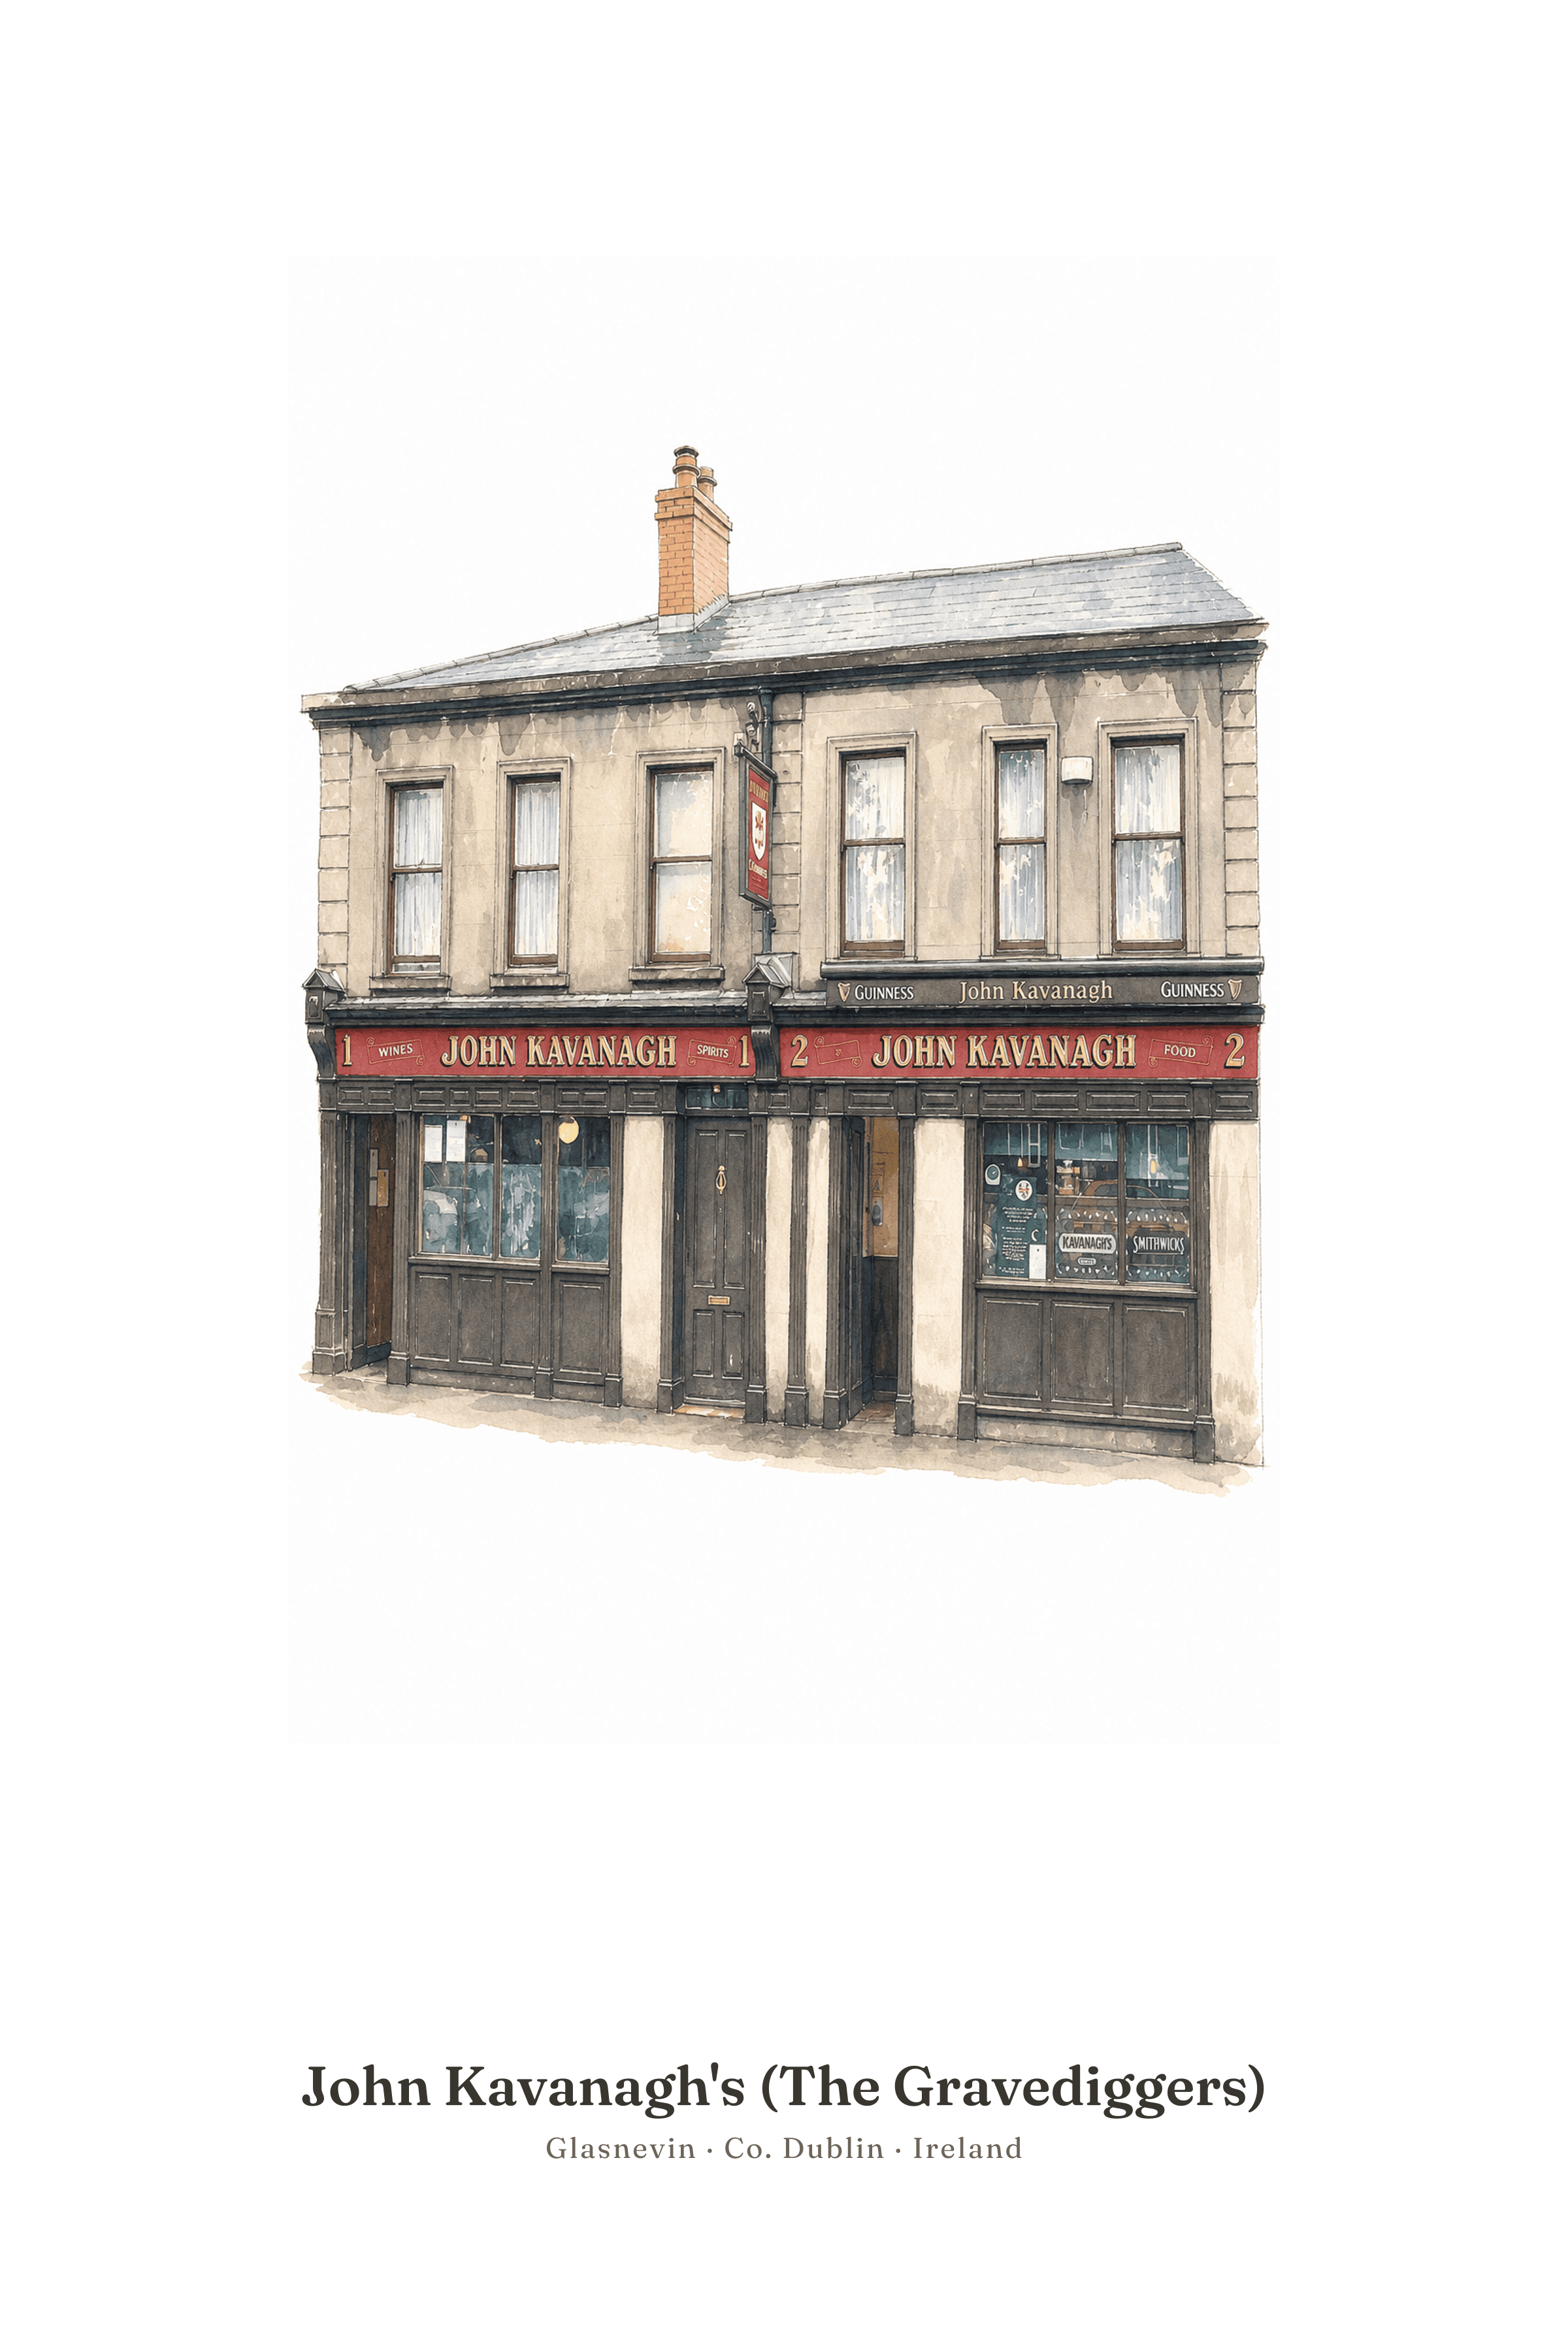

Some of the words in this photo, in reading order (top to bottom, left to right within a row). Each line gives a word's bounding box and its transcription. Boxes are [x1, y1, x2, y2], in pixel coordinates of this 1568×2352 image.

[855, 985, 914, 1000] GUINNESS
[958, 981, 1004, 1004] John
[1012, 980, 1113, 1004] Kavanagh
[1161, 981, 1224, 998] GUINNESS
[342, 1034, 352, 1066] 1
[378, 1043, 413, 1057] WINES
[440, 1035, 517, 1068] JOHN
[525, 1035, 677, 1068] KAVANAGH
[696, 1044, 729, 1058] SPIRITS
[739, 1035, 750, 1068] 1
[791, 1034, 809, 1068] 2
[872, 1035, 957, 1068] JOHN
[966, 1034, 1137, 1069] KAVANAGH
[1164, 1044, 1196, 1058] FOOD
[1224, 1033, 1245, 1069] 2
[1133, 1235, 1184, 1254] SMITHWICKS
